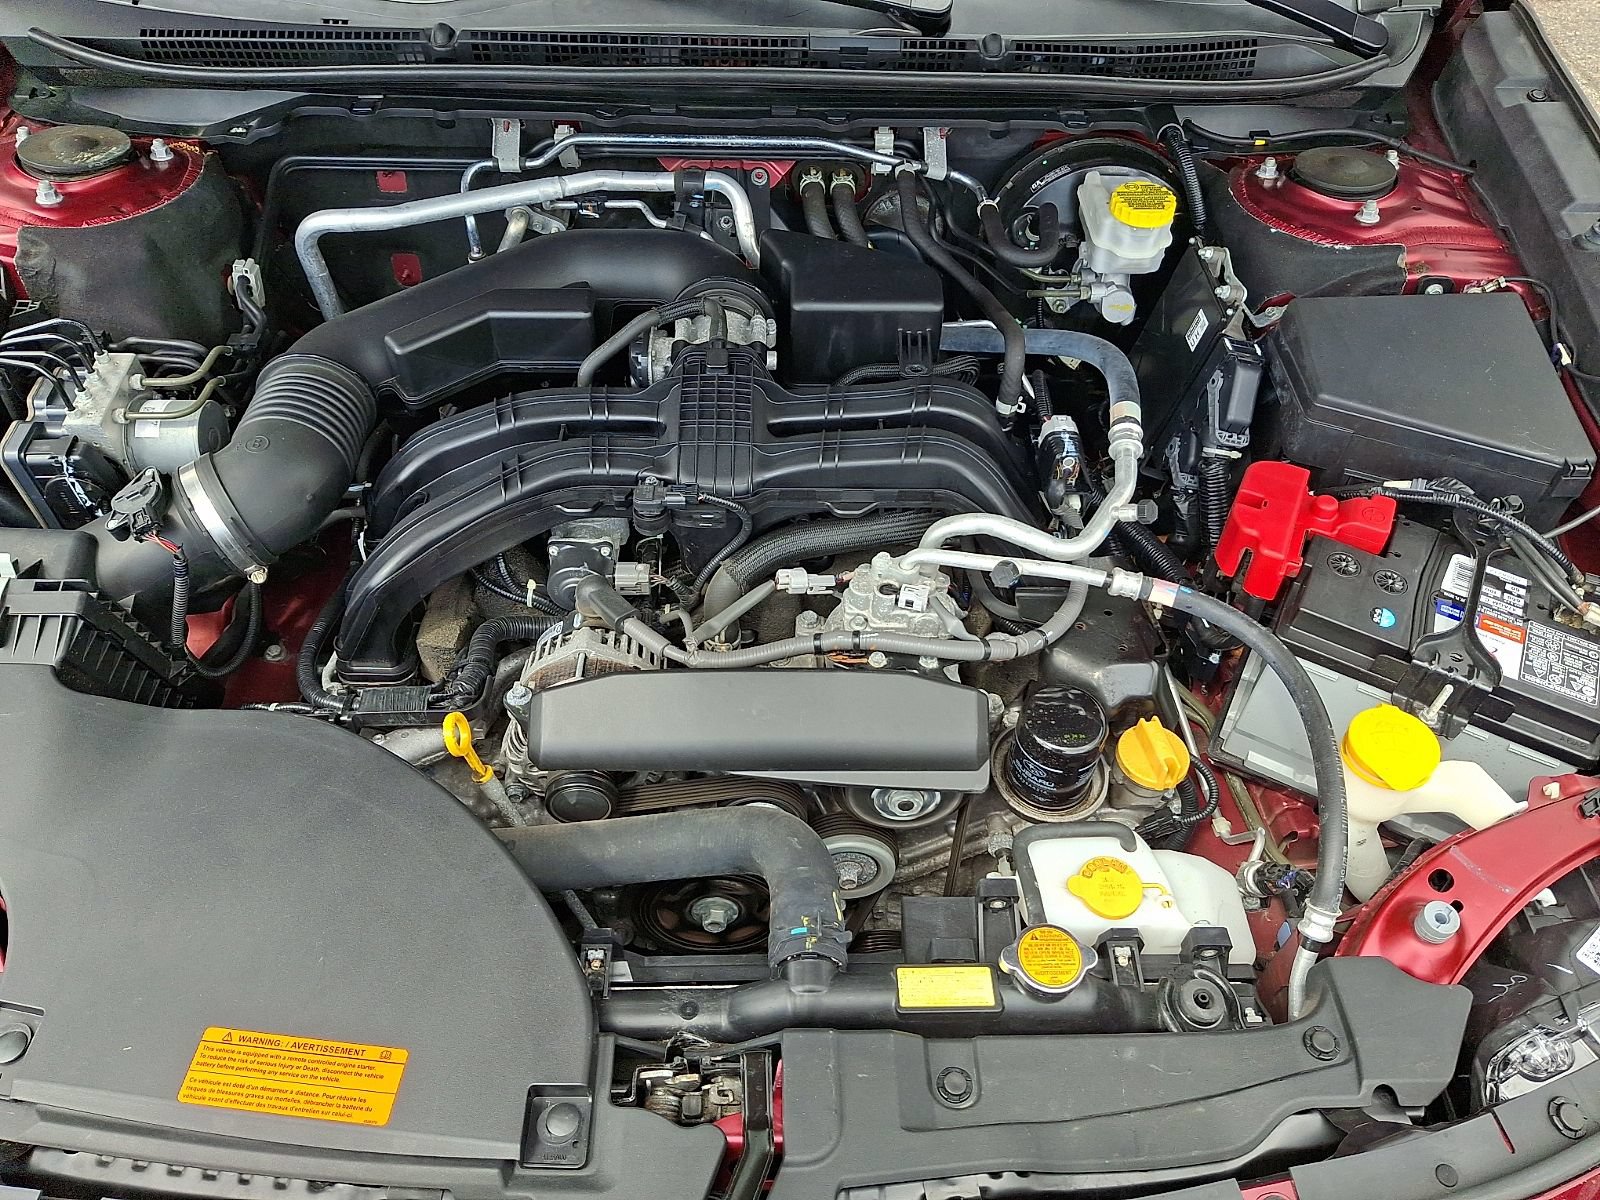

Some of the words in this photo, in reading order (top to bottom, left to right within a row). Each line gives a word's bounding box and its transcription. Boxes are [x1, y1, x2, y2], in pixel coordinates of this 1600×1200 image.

[1013, 759, 1055, 787] SUBARU
[290, 1041, 366, 1056] AVERTISSEMENT
[242, 1050, 268, 1058] equipped
[234, 1065, 266, 1074] performing
[321, 1067, 353, 1075] disconnect
